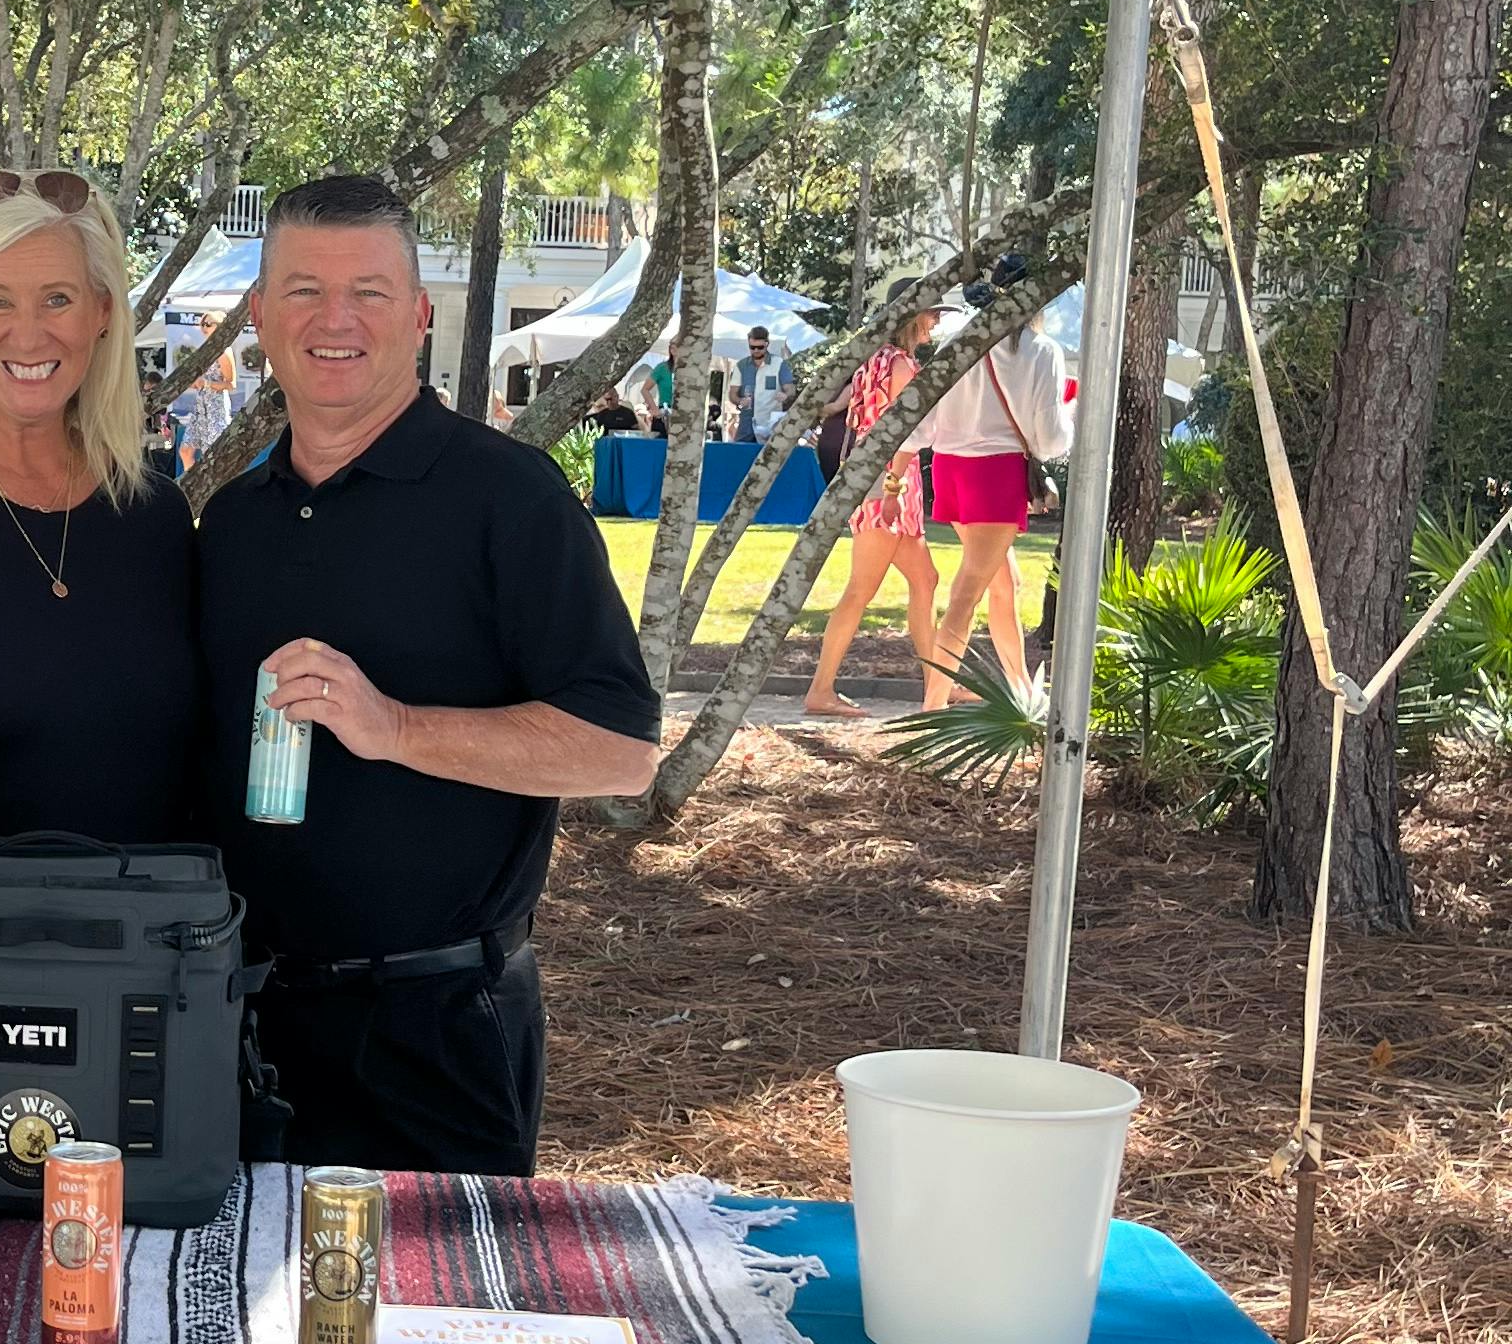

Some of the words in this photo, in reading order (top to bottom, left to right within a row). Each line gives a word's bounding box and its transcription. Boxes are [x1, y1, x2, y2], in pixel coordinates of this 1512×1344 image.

[1, 1023, 67, 1047] YETI
[20, 1096, 76, 1143] WEST
[312, 1229, 377, 1305] WESTERN
[63, 1289, 78, 1301] LA
[49, 1299, 96, 1314] PALOMA
[317, 1321, 356, 1334] RANCH
[317, 1334, 355, 1344] WATER
